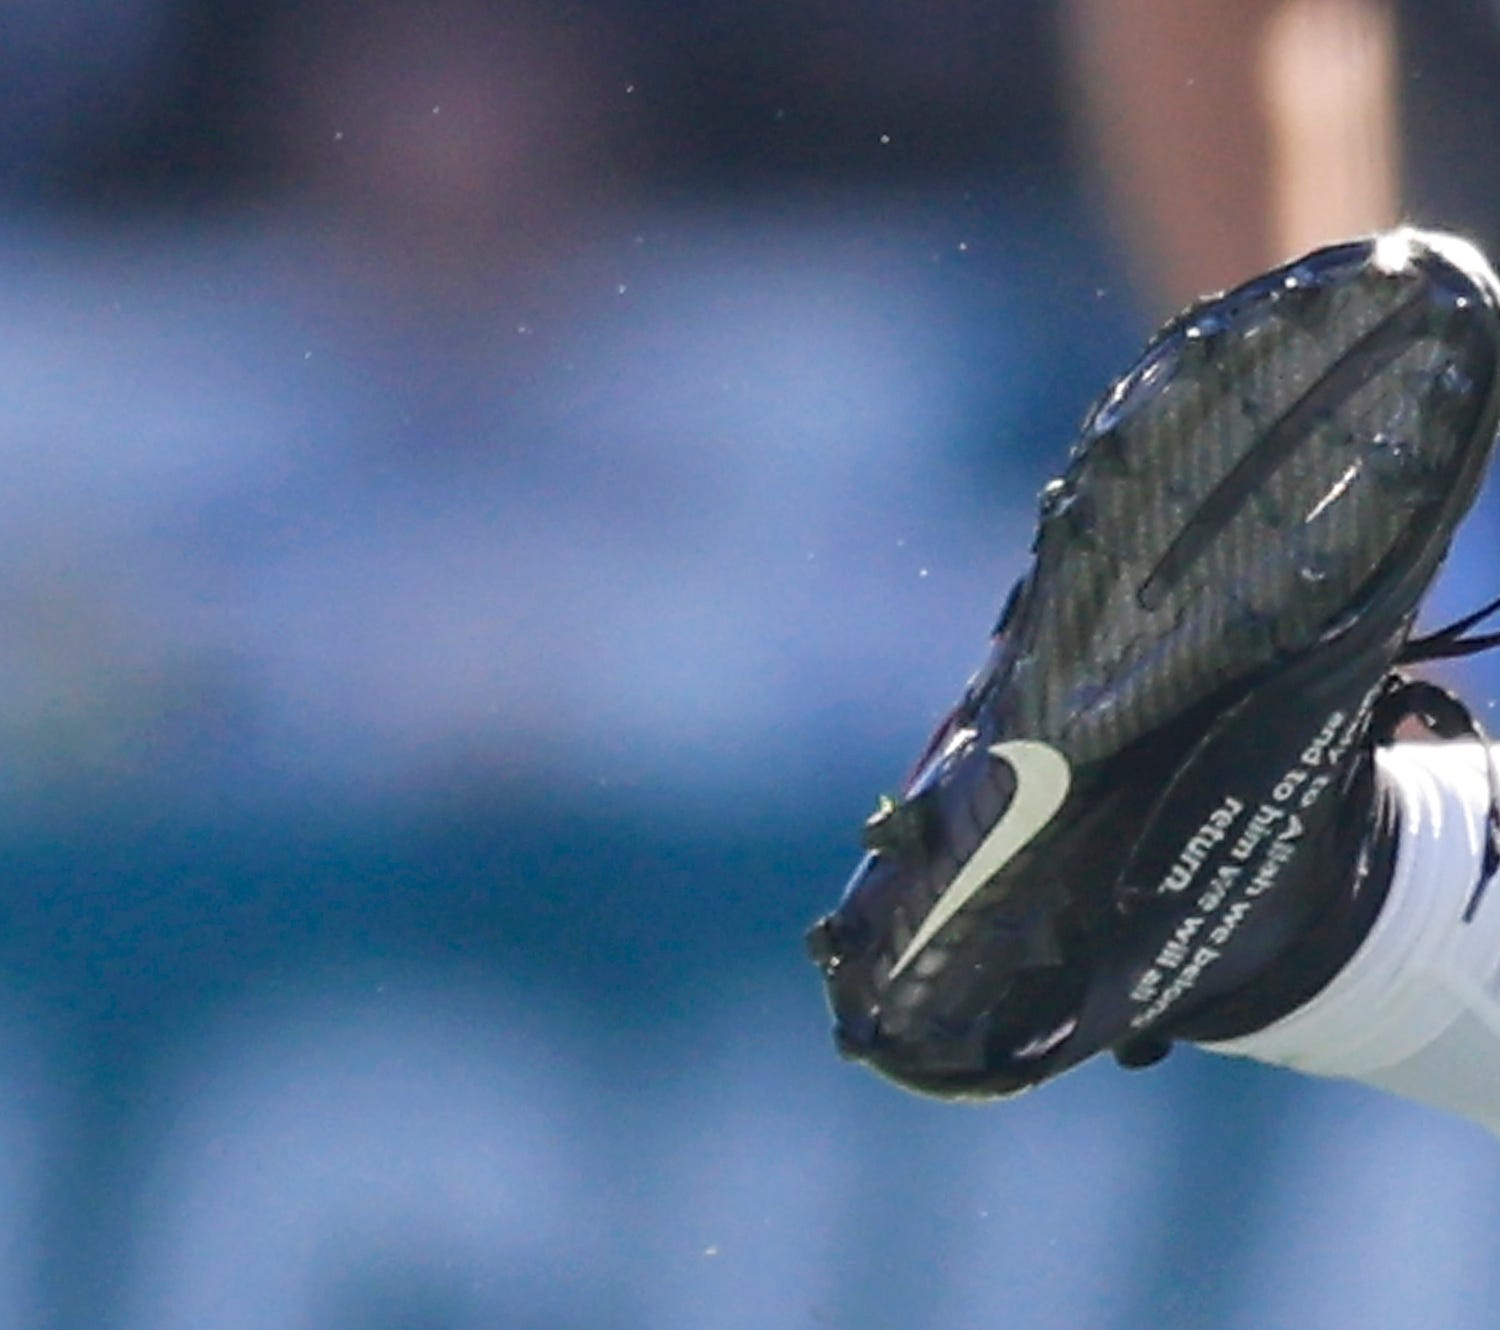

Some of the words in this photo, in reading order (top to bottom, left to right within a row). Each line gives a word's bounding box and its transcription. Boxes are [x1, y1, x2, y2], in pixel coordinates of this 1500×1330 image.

[1297, 714, 1343, 765] and
[1269, 771, 1306, 802] to
[1155, 794, 1245, 899] return.
[1229, 803, 1283, 861] him
[1242, 813, 1303, 899] Allah
[1195, 864, 1240, 913] we
[1153, 915, 1201, 967] will
[1209, 901, 1249, 945] we
[1128, 966, 1159, 1000] all
